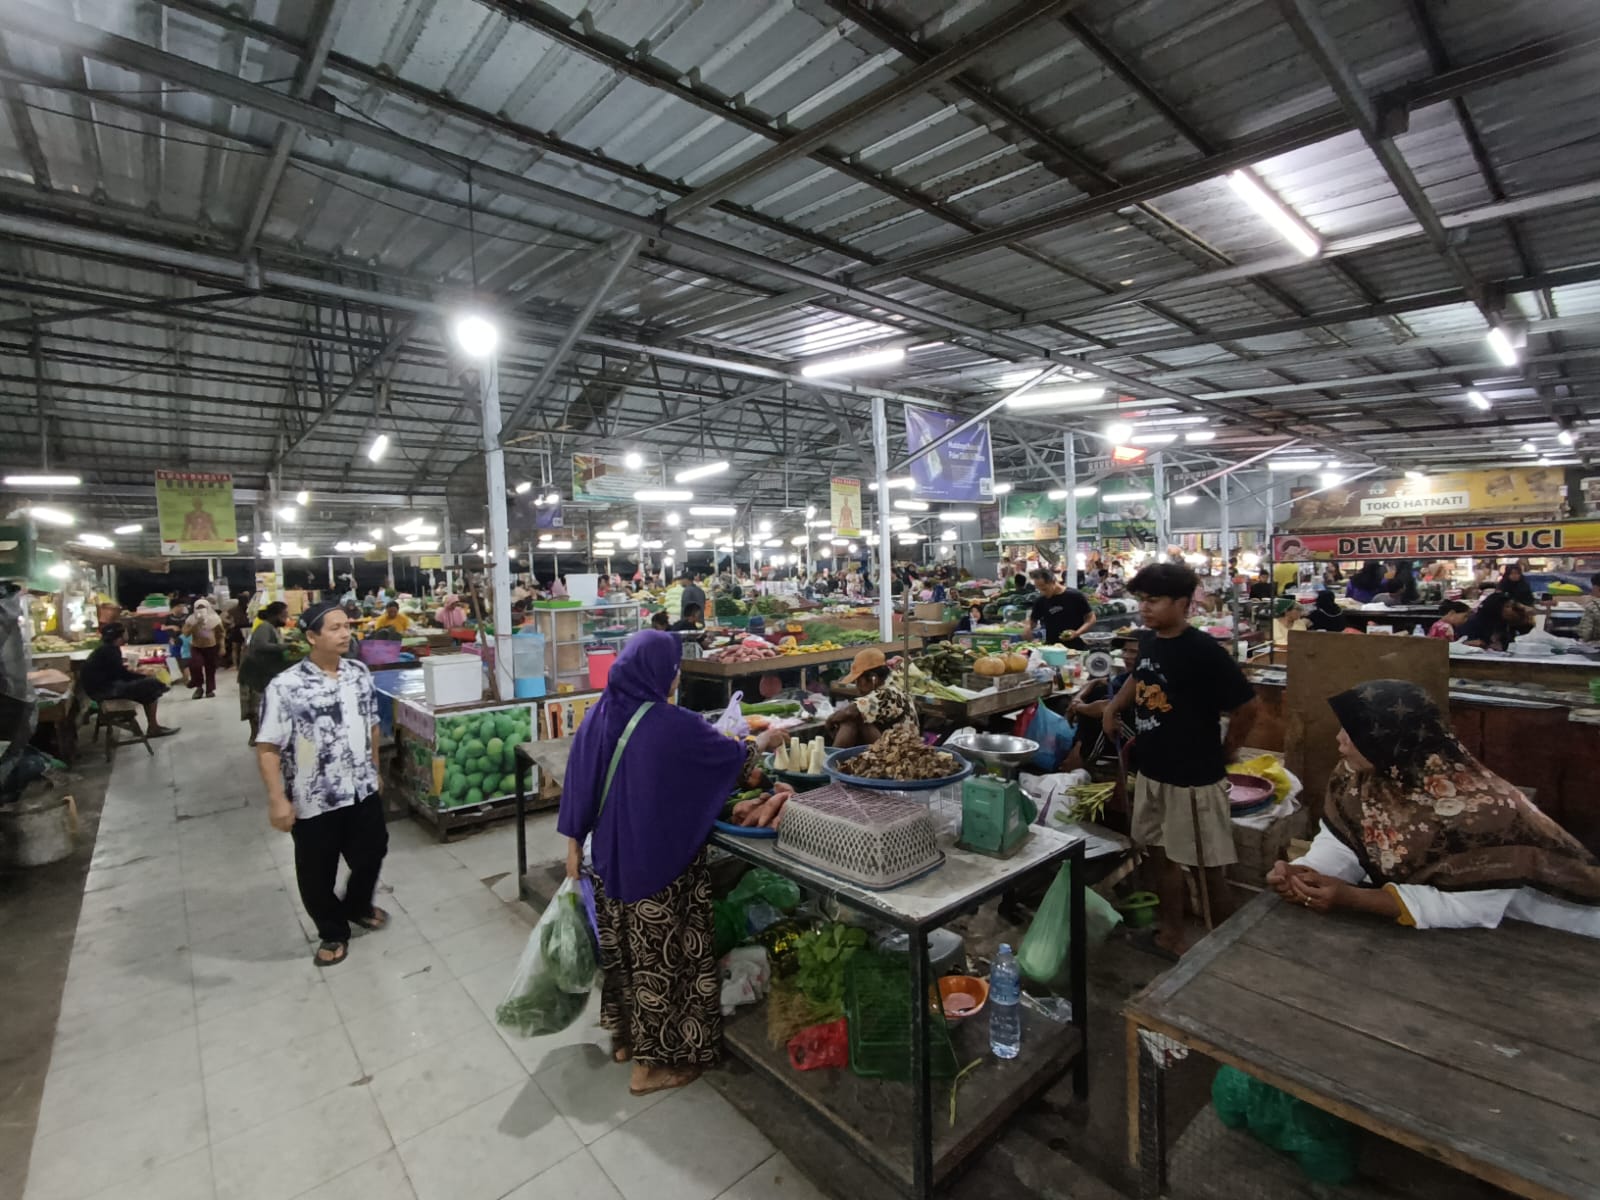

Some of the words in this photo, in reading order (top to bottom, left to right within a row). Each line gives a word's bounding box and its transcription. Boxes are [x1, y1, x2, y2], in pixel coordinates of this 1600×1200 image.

[1366, 500, 1400, 511] TOKO
[1404, 496, 1463, 508] HATNATI
[1338, 536, 1407, 555] DEWI
[1416, 531, 1474, 553] KILI
[1485, 527, 1563, 551] SUCI
